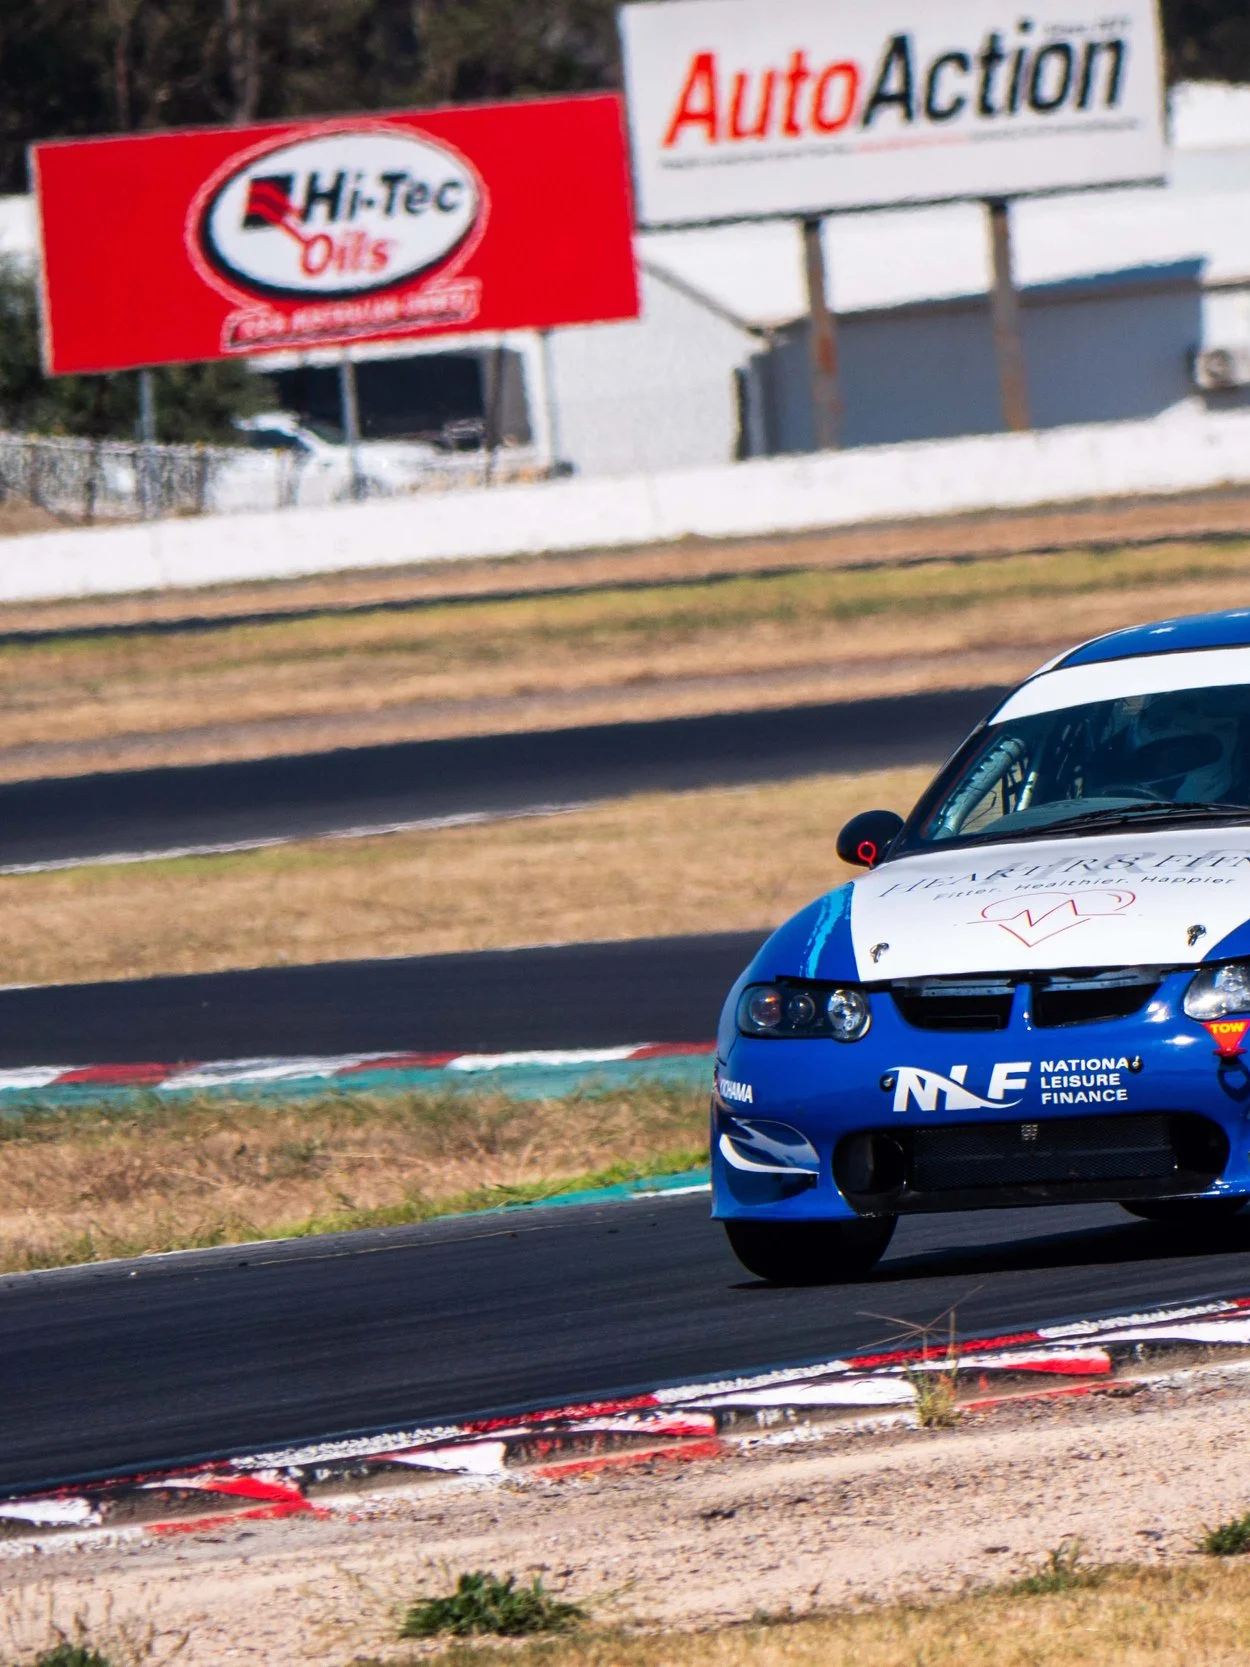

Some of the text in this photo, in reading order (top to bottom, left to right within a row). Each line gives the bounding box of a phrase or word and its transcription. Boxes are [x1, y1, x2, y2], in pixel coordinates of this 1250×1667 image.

[662, 18, 1126, 149] AutoAction
[302, 169, 464, 223] Hi-Tec
[301, 231, 392, 277] Oils
[1014, 876, 1129, 891] Healthier.
[1140, 875, 1237, 886] Happier
[1210, 1022, 1245, 1034] TOW
[1040, 1057, 1130, 1073] NATIONA
[885, 1061, 1032, 1112] NLF
[1040, 1073, 1121, 1089] LEISURE
[1041, 1088, 1128, 1105] FINANCE
